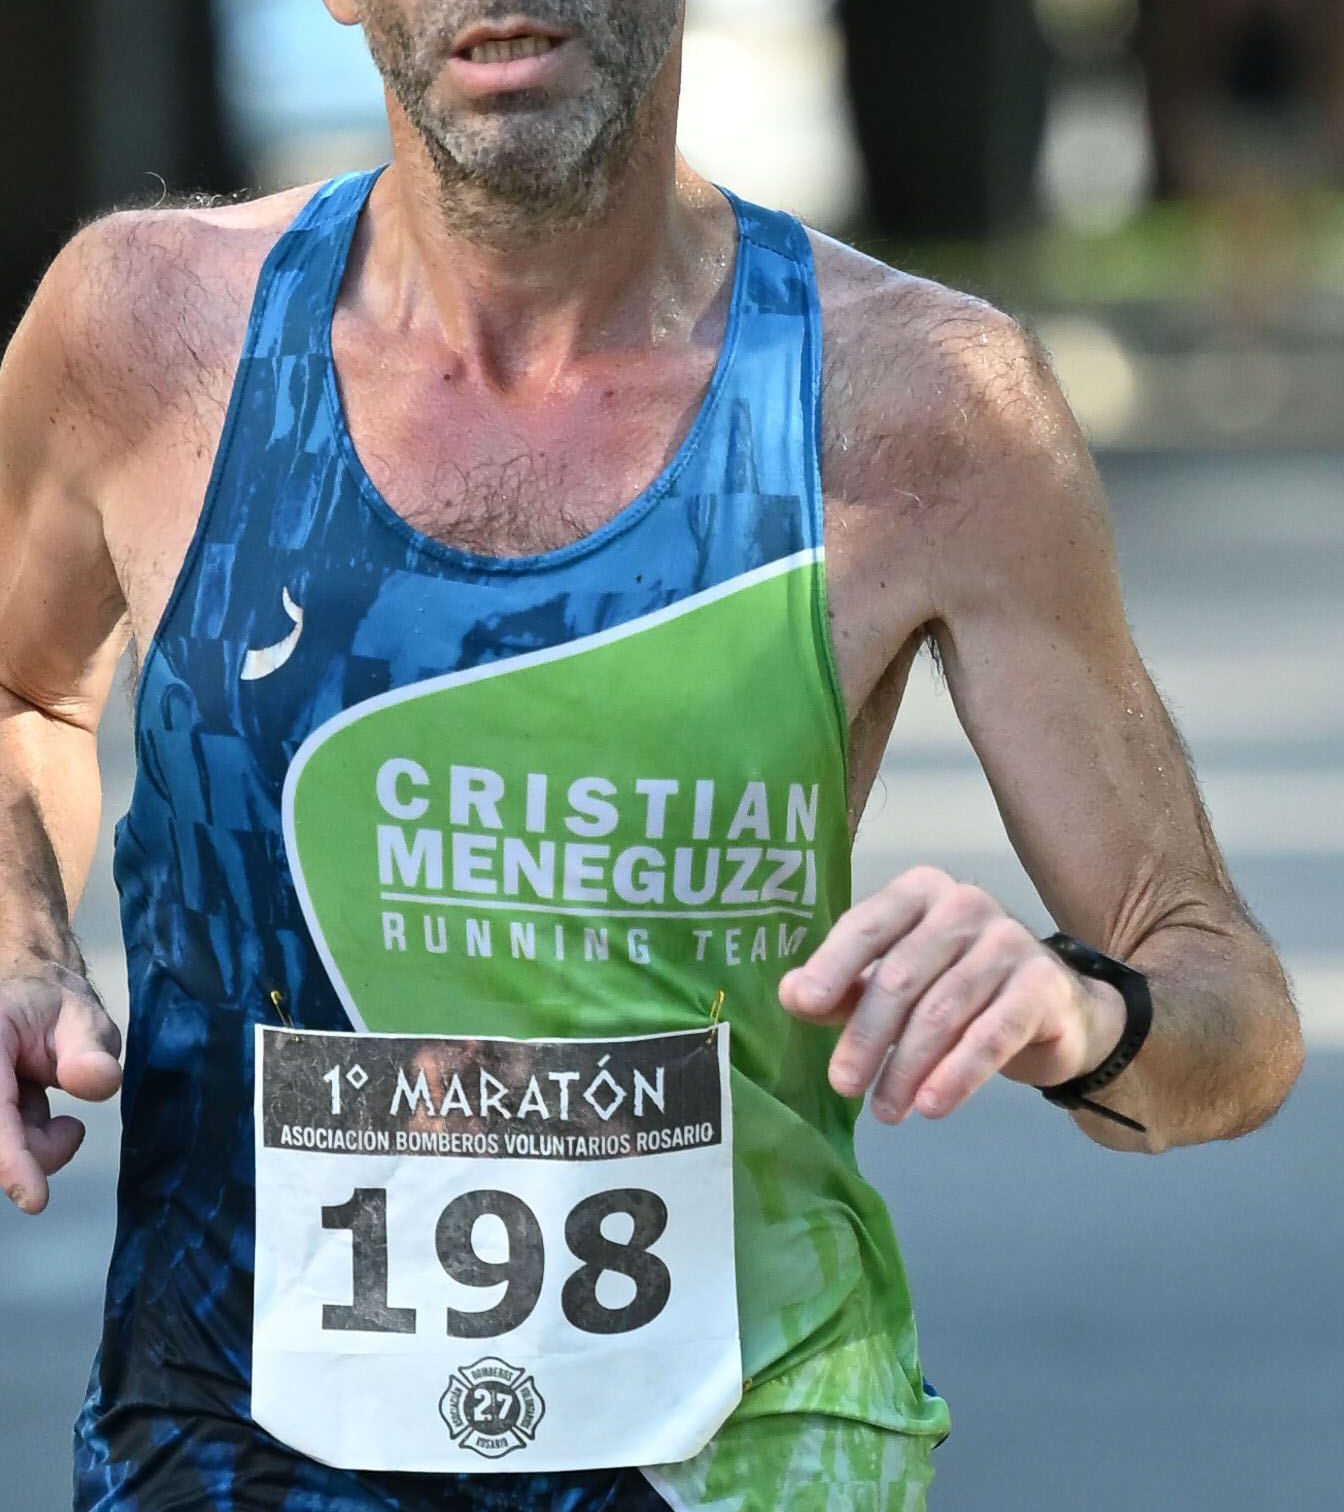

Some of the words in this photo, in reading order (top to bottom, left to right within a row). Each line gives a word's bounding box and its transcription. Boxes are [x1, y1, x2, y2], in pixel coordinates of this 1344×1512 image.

[375, 757, 819, 843] CRISTIAN
[375, 824, 817, 906] MENEGUZZI
[382, 911, 651, 965] RUNNING
[692, 922, 808, 966] TEAM
[388, 1054, 666, 1121] MARATÓN
[280, 1124, 390, 1152] ASOCIACIÓN
[396, 1130, 499, 1155] BOMBEROS
[505, 1129, 631, 1156] VOLUNTARIOS
[636, 1122, 715, 1152] ROSARIO
[321, 1187, 672, 1339] 198
[474, 1389, 512, 1421] 27
